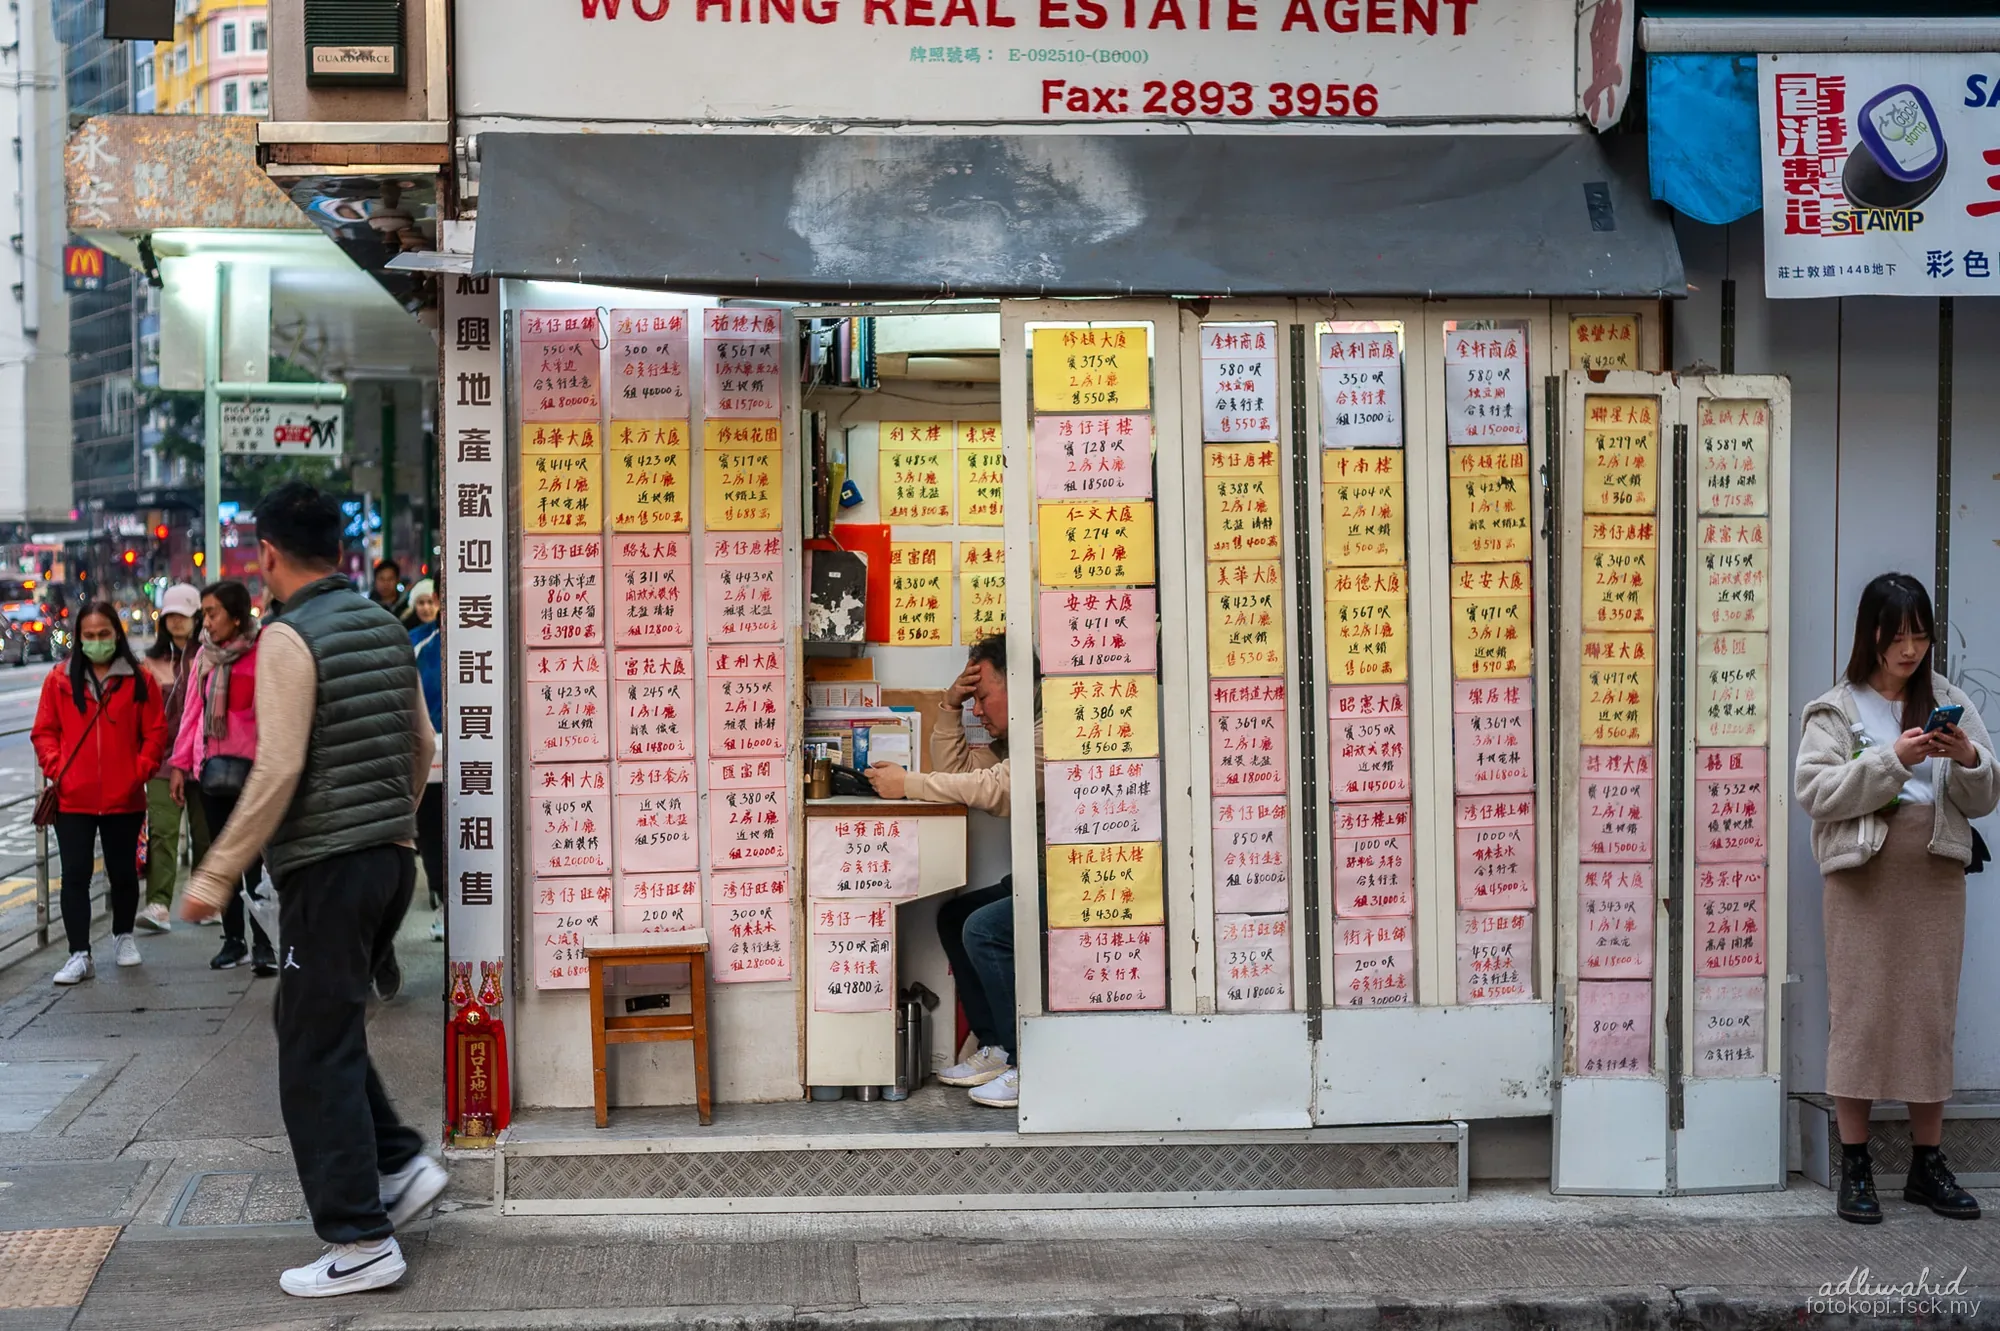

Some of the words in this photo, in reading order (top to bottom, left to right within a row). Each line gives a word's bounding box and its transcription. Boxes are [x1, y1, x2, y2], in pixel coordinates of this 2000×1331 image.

[581, 0, 668, 21] WO
[697, 0, 838, 25] HING
[864, 0, 1016, 27] REAL
[1040, 0, 1258, 31] ESTATE
[1282, 0, 1478, 36] AGENT
[317, 55, 390, 63] GUARDFORCE
[1041, 79, 1129, 114] Fax:
[1143, 80, 1253, 116] 2893
[1268, 82, 1378, 117] 3956
[70, 124, 119, 222] 永安
[1832, 208, 1924, 232] STAMP
[625, 344, 670, 356] 300呎
[1220, 362, 1261, 376] 580呎
[1339, 371, 1385, 385] 350呎
[1232, 832, 1273, 845] 850呎
[1477, 829, 1520, 842] 1000呎
[846, 842, 889, 854] 350呎
[1355, 838, 1398, 852] 1000呎
[642, 908, 683, 922] 200呎
[730, 909, 773, 922] 300呎
[557, 916, 598, 928] 260呎
[1096, 949, 1141, 963] 150呎
[1356, 958, 1394, 971] 200呎
[1593, 1020, 1635, 1032] 800呎
[1708, 1016, 1750, 1028] 300呎
